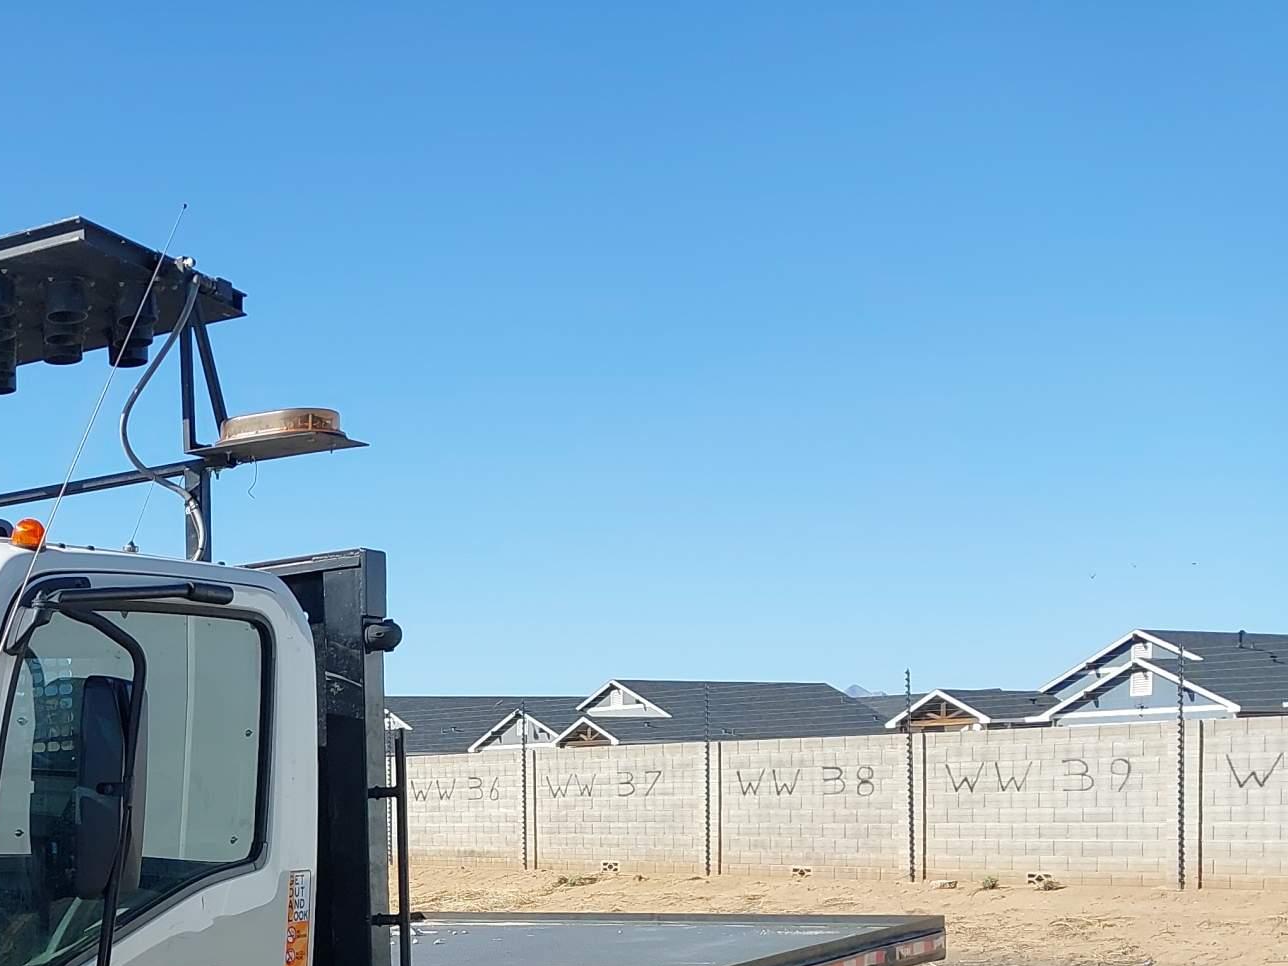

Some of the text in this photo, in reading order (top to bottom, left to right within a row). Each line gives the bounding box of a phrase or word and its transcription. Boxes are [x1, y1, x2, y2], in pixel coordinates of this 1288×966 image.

[616, 770, 662, 798] 37
[822, 766, 875, 797] 38
[1061, 758, 1132, 793] 39
[468, 776, 500, 802] 36
[289, 873, 305, 887] GET
[288, 886, 305, 898] OUT
[288, 899, 305, 910] AND
[287, 910, 309, 922] LOOK
